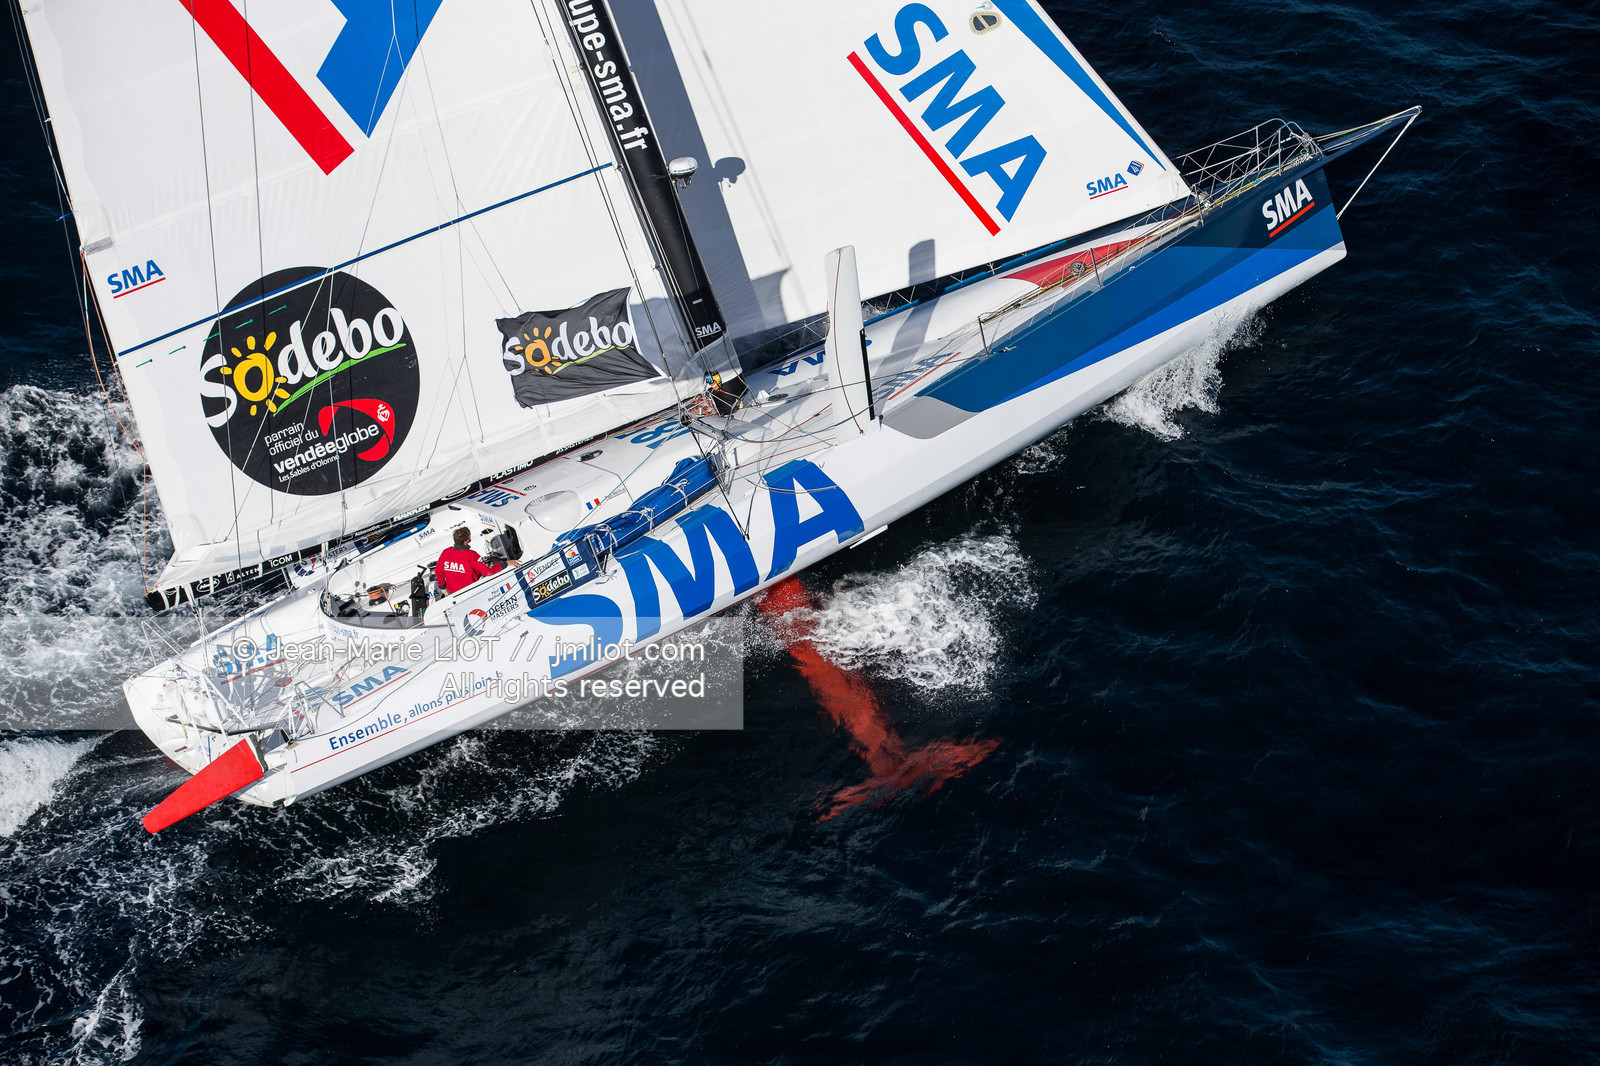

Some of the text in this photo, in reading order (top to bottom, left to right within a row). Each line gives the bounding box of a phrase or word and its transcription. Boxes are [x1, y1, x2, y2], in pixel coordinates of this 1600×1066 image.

[864, 2, 1047, 222] SMA
[1086, 173, 1127, 196] SMA
[1262, 178, 1313, 230] SMA
[107, 259, 164, 294] SMA
[695, 322, 721, 335] SMA
[504, 316, 633, 376] Sodebo
[200, 307, 404, 427] Sodebo
[264, 422, 304, 447] parrain
[269, 429, 319, 456] officiel du
[278, 475, 290, 483] Les
[289, 466, 311, 479] Sables
[490, 460, 533, 482] PLASTIMO
[418, 528, 435, 539] SMA
[444, 561, 465, 571] SMA
[528, 459, 865, 682] SMA
[331, 665, 408, 706] SMA
[329, 711, 407, 750] Ensemble,
[408, 697, 443, 718] allons
